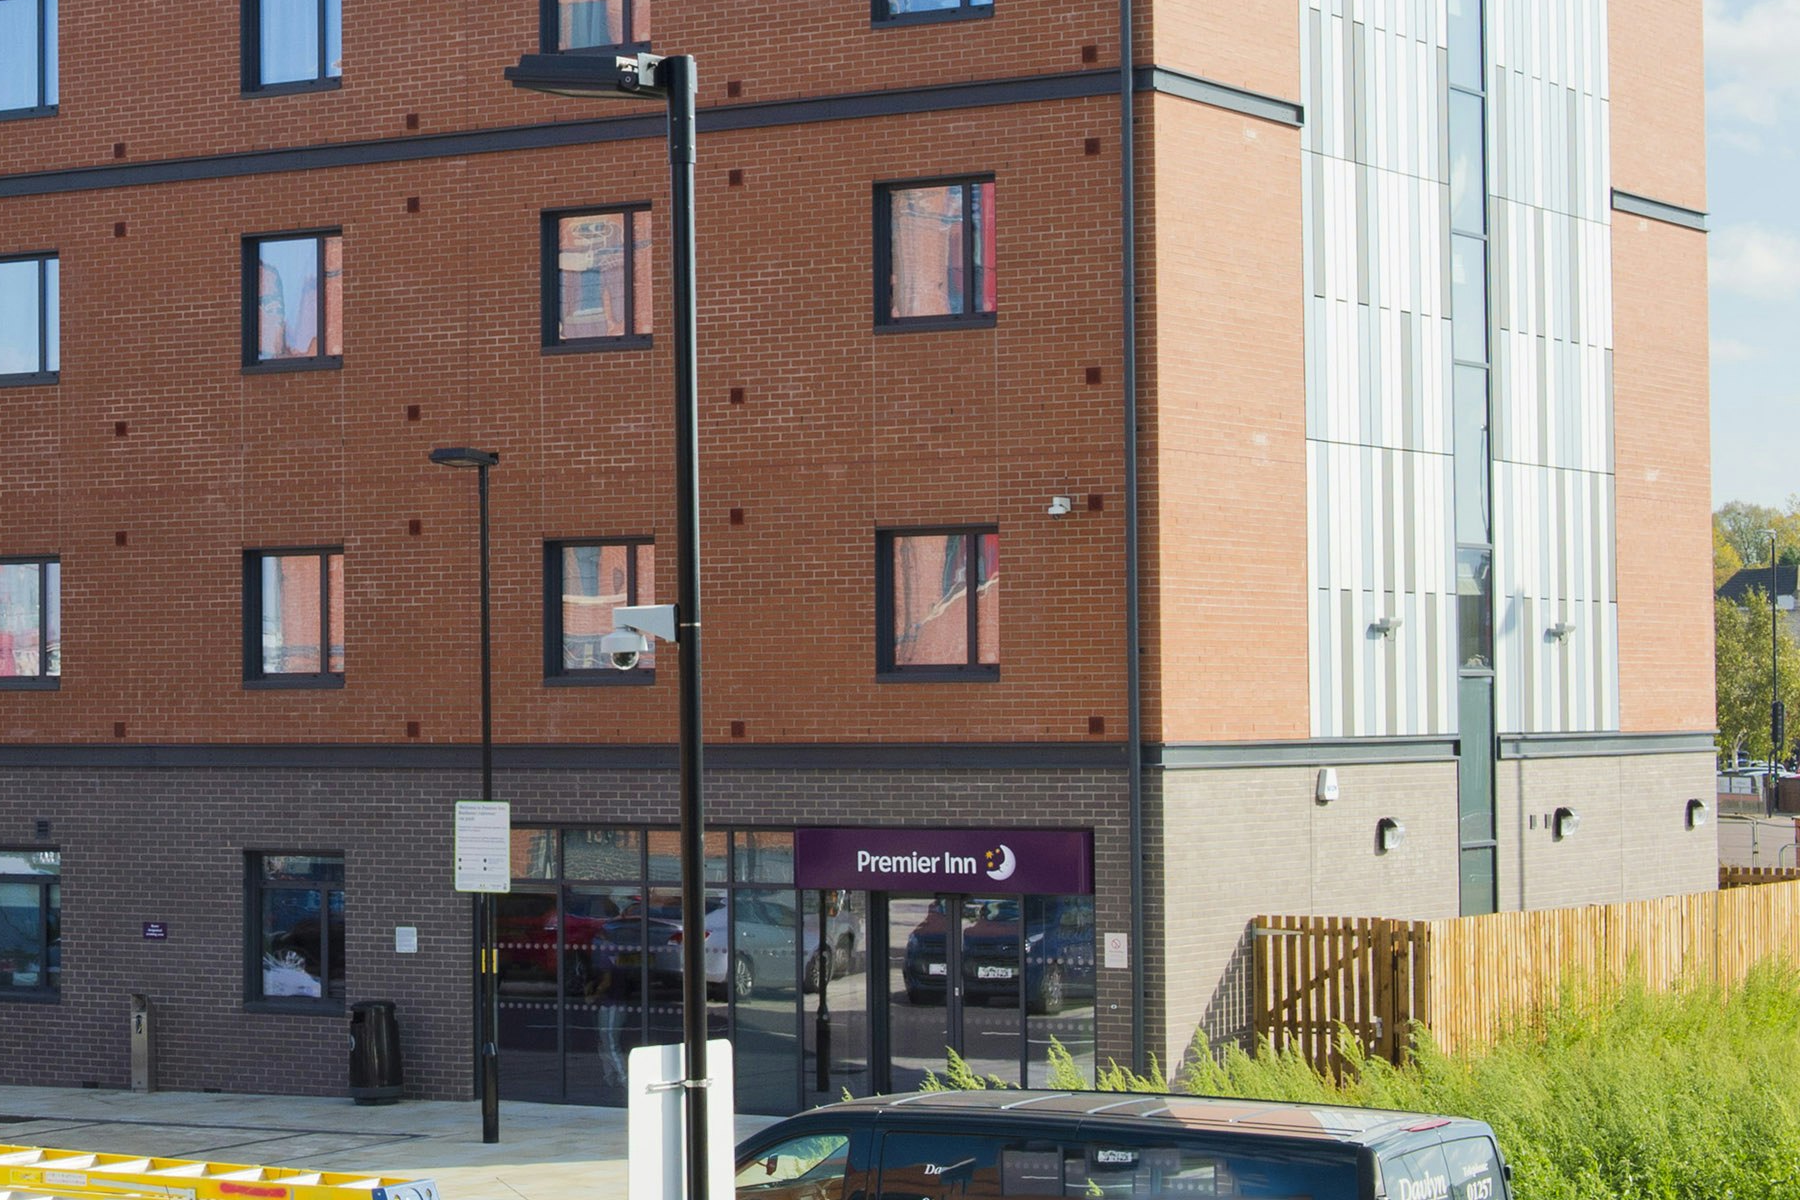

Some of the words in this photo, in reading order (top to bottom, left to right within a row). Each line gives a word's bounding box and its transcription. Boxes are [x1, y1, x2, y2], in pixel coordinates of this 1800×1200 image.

[857, 850, 940, 874] Premier
[944, 851, 977, 874] Inn
[1466, 1177, 1492, 1200] 01257
